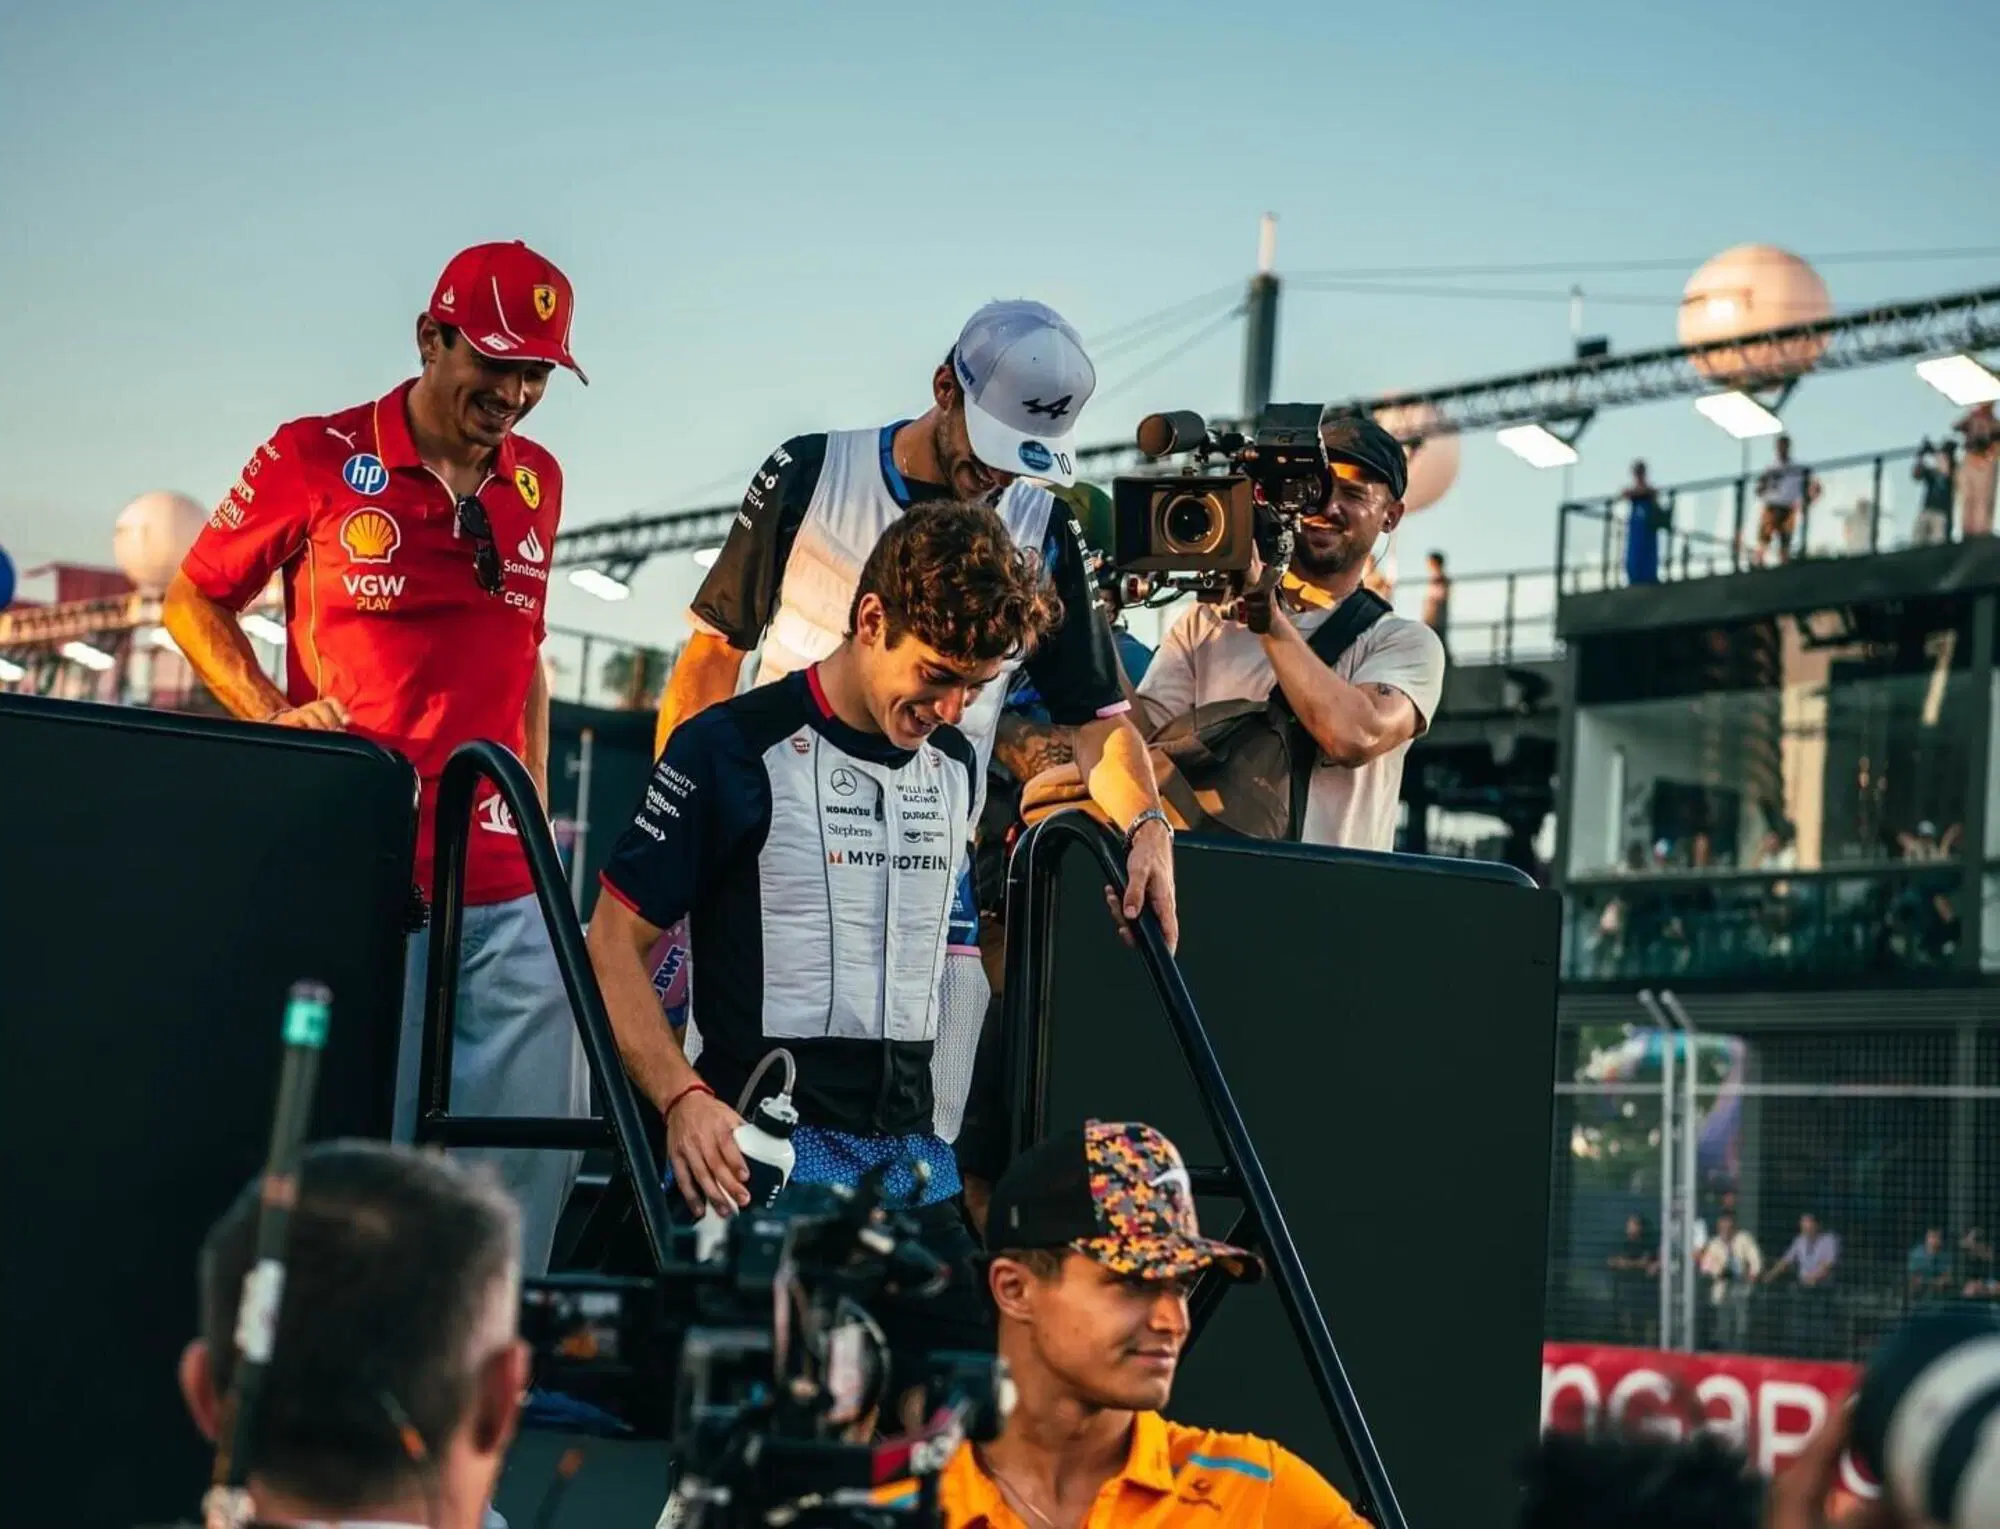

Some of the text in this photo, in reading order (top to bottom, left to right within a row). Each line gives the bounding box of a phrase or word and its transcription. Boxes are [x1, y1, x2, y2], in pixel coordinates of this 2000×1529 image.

[1053, 452, 1072, 476] 10
[351, 456, 381, 493] hp
[342, 574, 406, 597] VGW
[356, 597, 392, 611] PLAY
[902, 795, 938, 804] RACING
[825, 805, 871, 817] KOMATSU
[826, 823, 873, 839] Stephens
